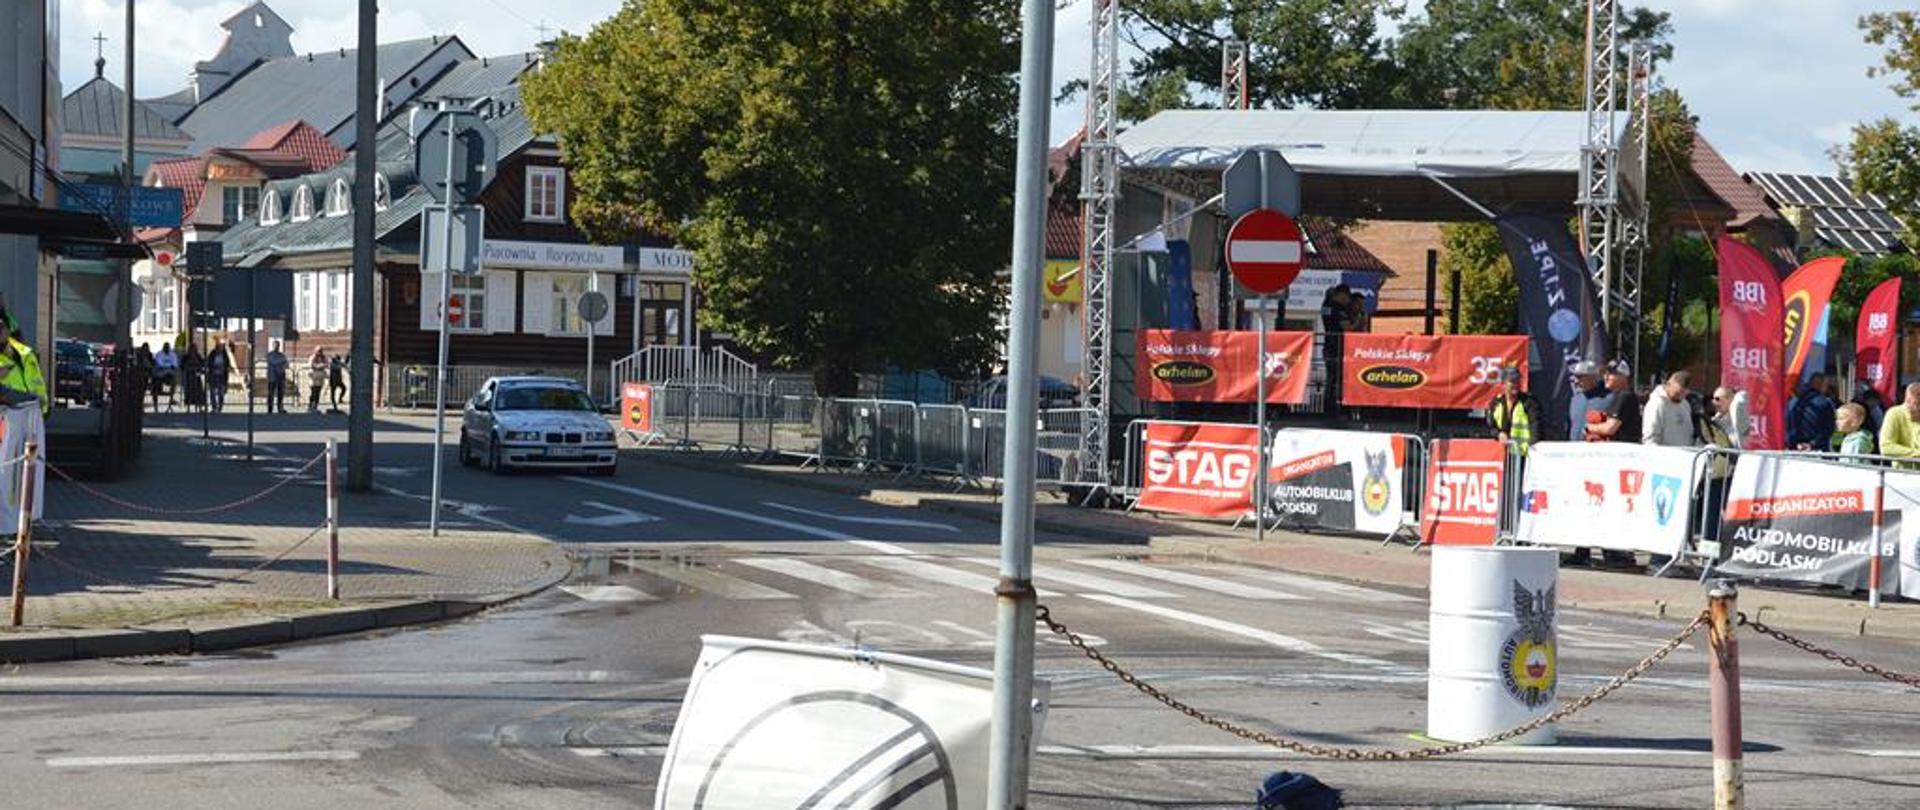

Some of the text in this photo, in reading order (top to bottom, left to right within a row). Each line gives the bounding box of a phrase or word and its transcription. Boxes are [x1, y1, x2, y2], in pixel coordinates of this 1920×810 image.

[1185, 343, 1222, 357] Sklepy
[1354, 347, 1432, 362] Polskie Sklepy
[1158, 366, 1208, 379] arhelan
[1366, 370, 1419, 383] arhelan
[1469, 355, 1502, 384] 35
[1148, 449, 1251, 489] STAG
[1431, 471, 1499, 514] STAG
[1750, 496, 1858, 515] ORGANIZATOR
[1732, 546, 1823, 570] PODLASKI
